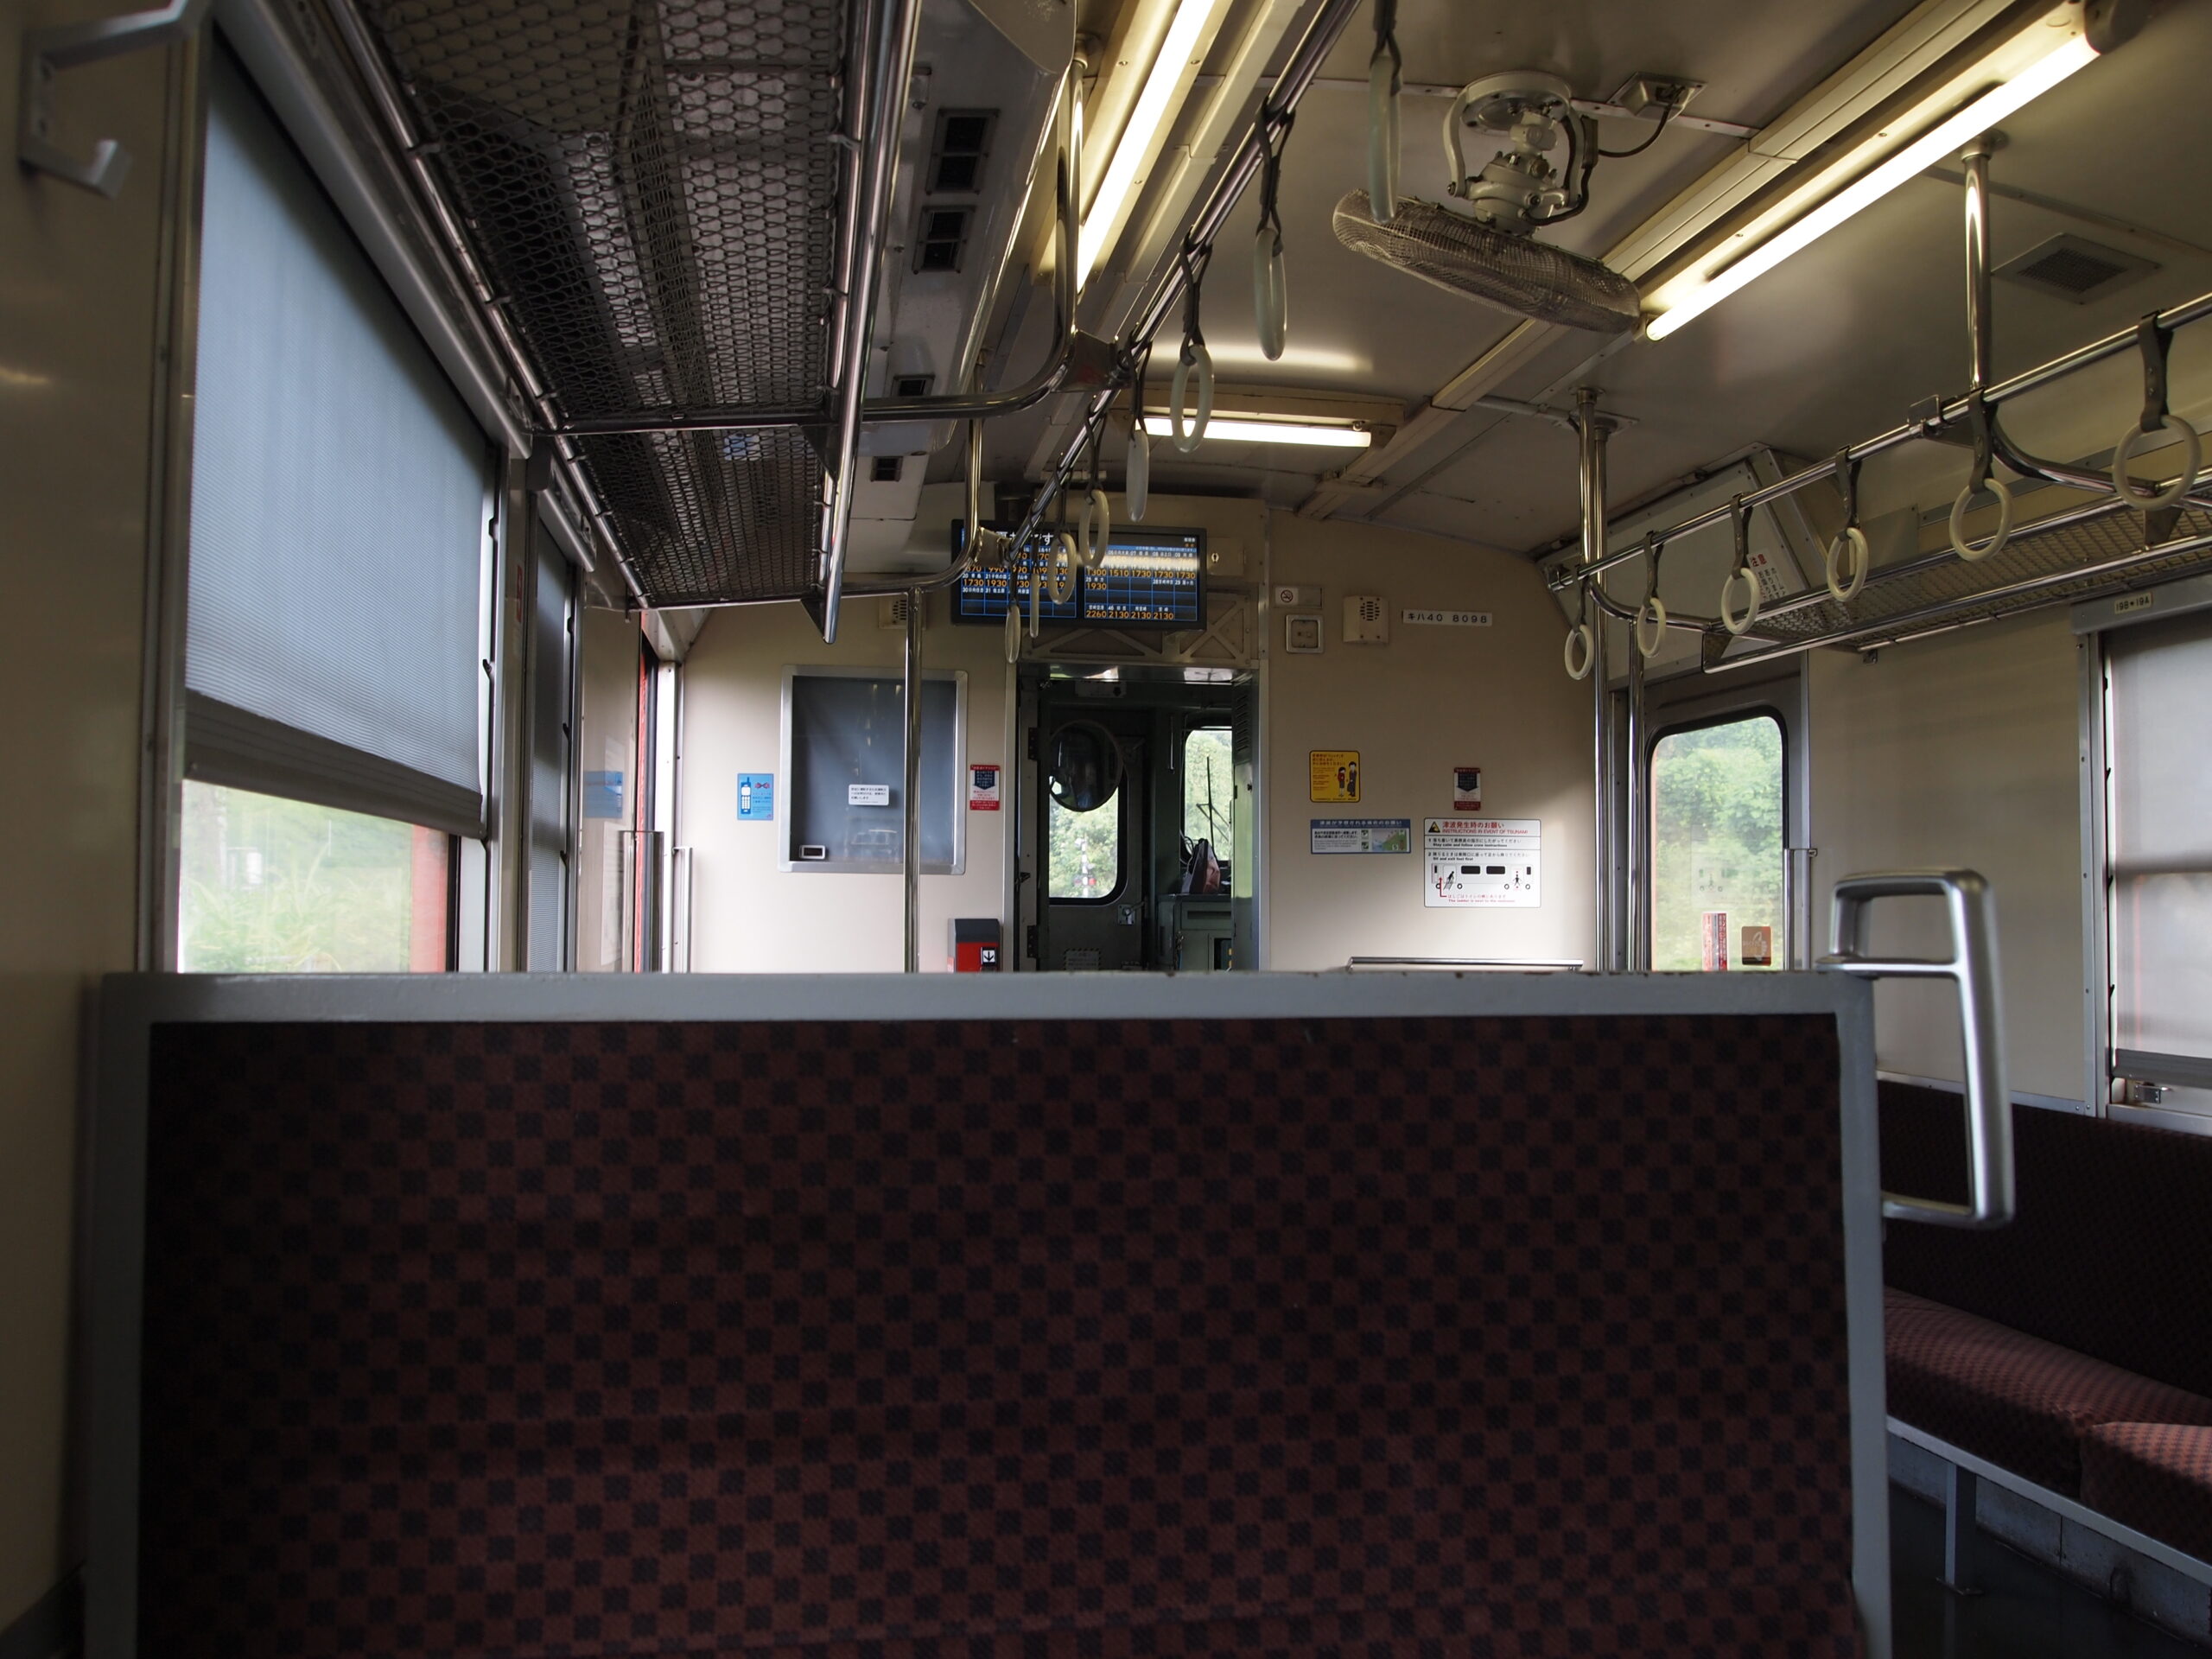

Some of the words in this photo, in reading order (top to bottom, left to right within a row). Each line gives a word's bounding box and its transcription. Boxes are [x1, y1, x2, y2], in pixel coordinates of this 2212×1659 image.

[1154, 570, 1173, 579] 1730
[1175, 571, 1196, 580] 1730
[963, 578, 984, 587] 1730
[986, 579, 1007, 588] 1930
[1408, 613, 1443, 622] キハ40
[1452, 614, 1487, 623] 8098
